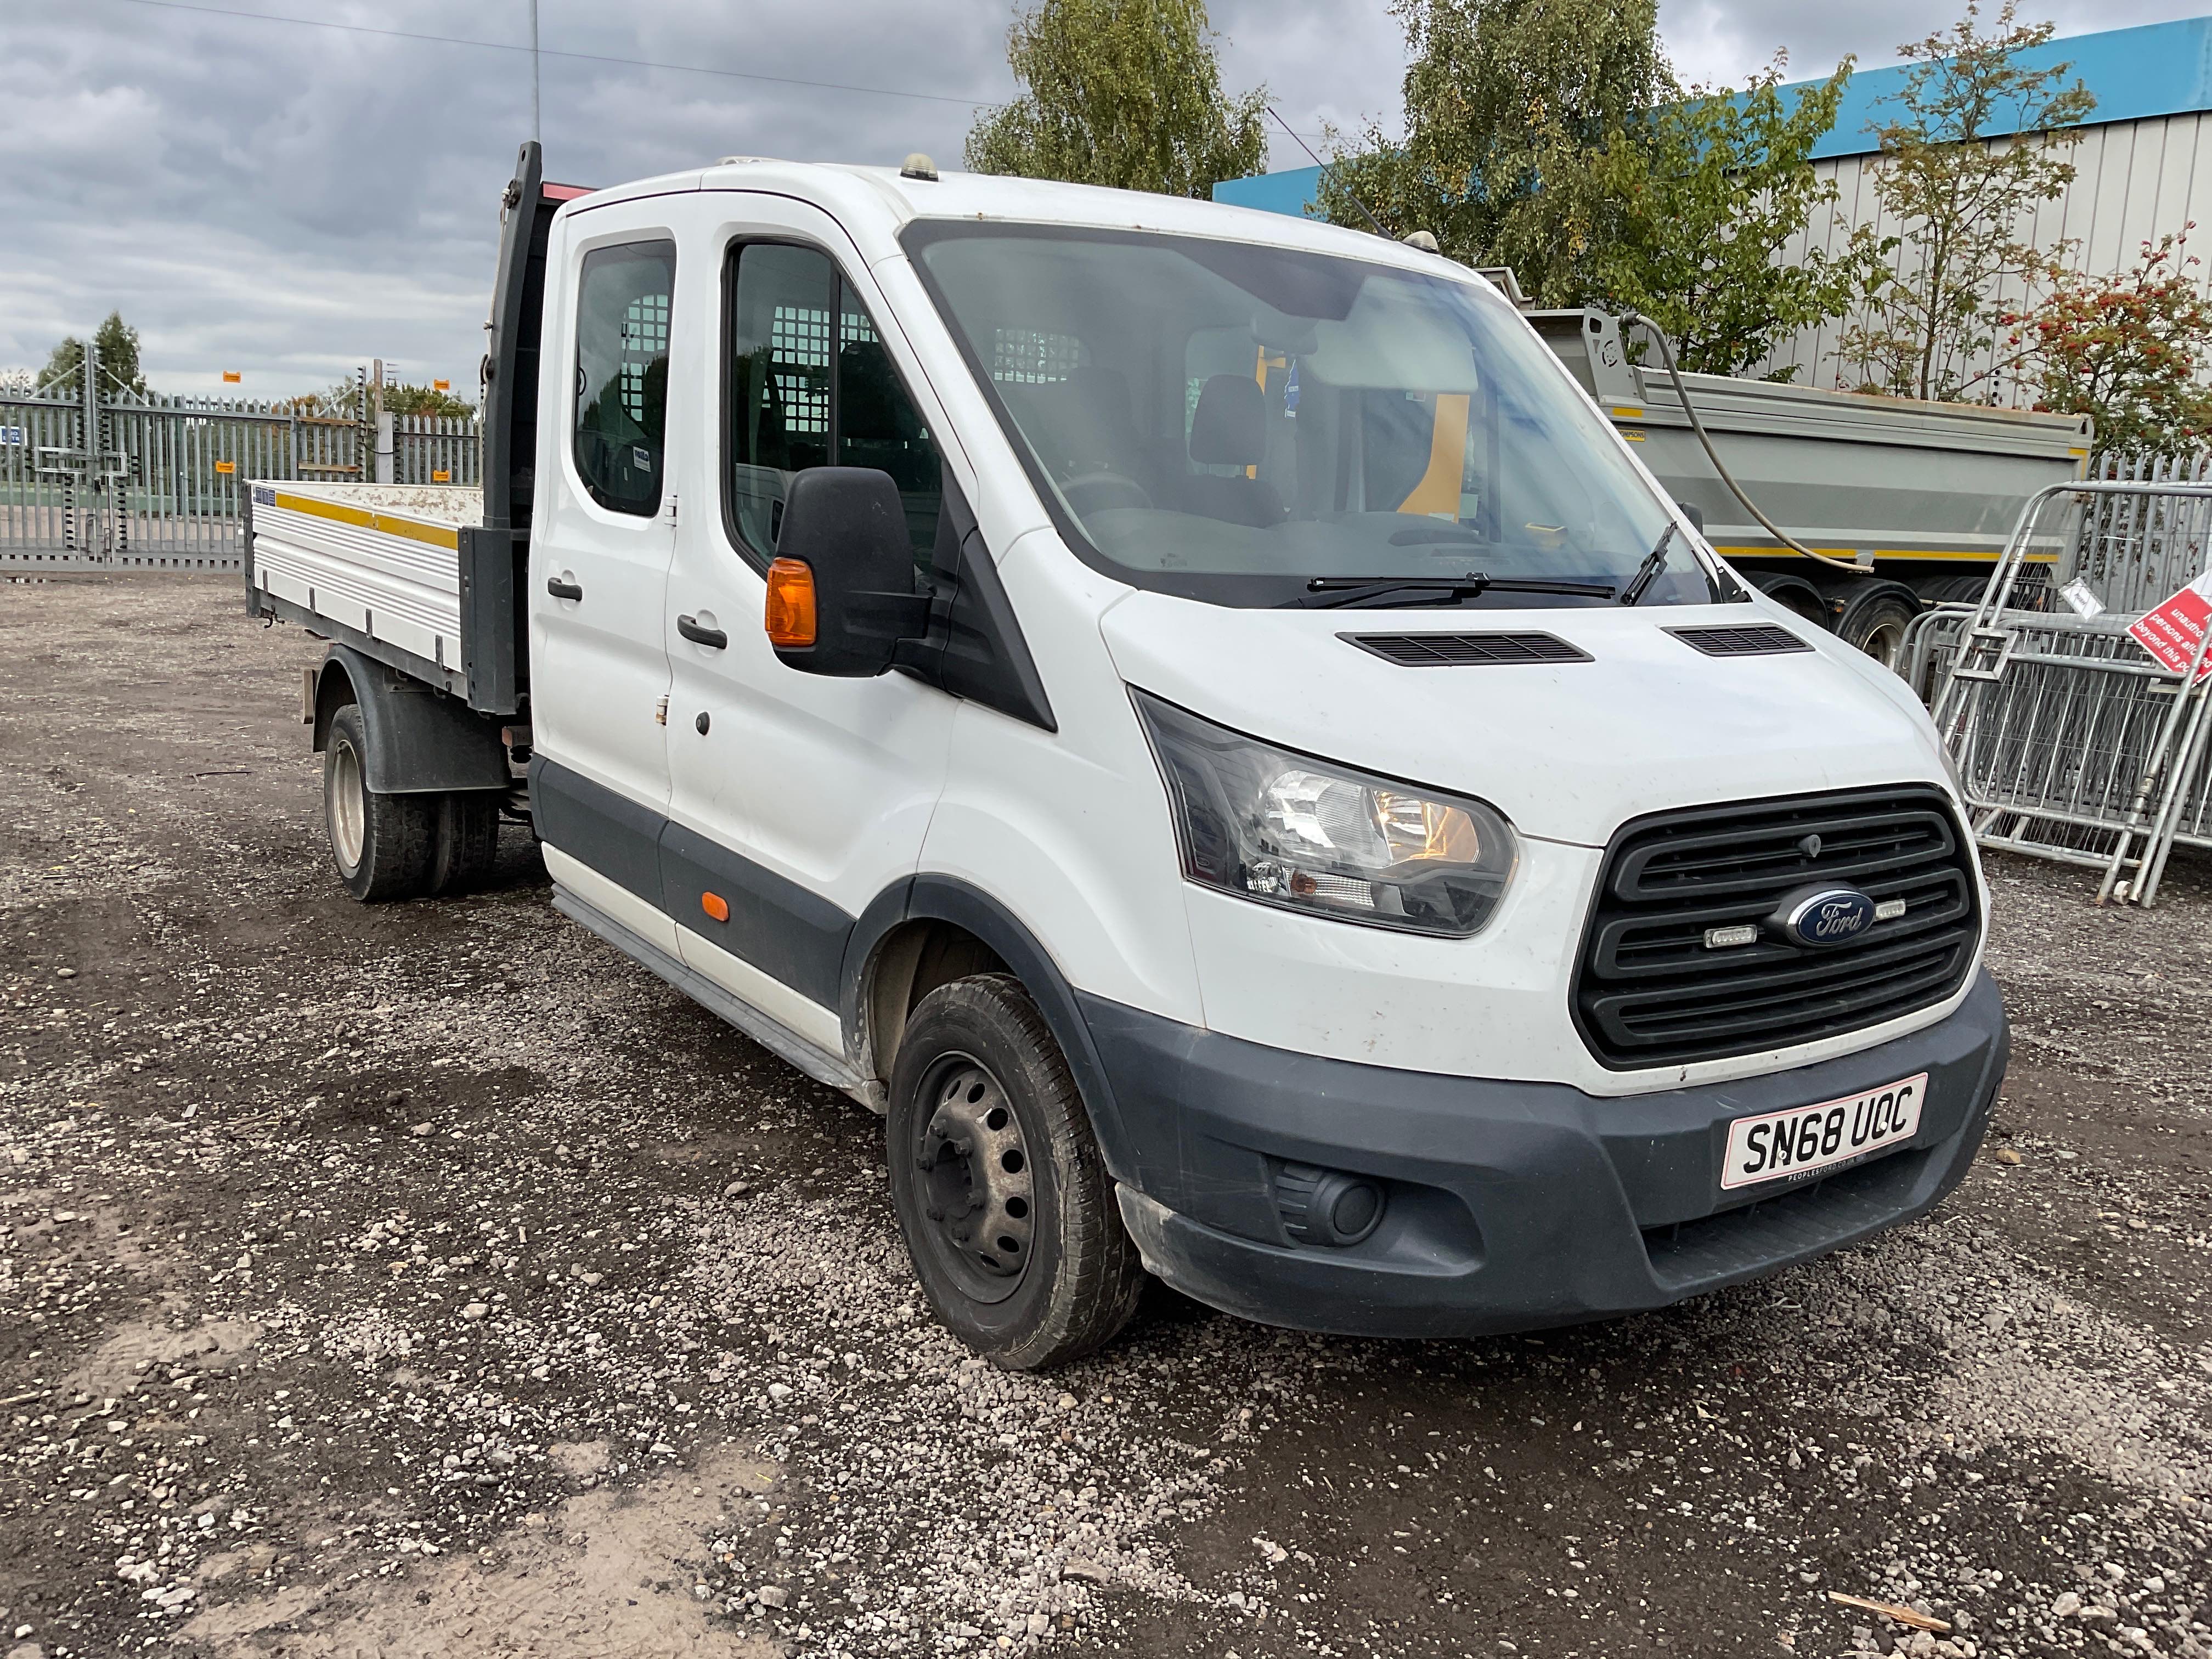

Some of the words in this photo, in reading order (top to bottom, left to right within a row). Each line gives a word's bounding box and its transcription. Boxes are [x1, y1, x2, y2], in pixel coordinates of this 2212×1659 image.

[2135, 621, 2168, 648] beyond
[2163, 646, 2181, 663] this
[2175, 661, 2202, 681] pot
[2149, 613, 2184, 642] persons
[2181, 641, 2212, 668] alloed
[2171, 608, 2212, 648] unautho
[1816, 901, 1864, 936] Ford
[1743, 1107, 1846, 1173] SN68
[1851, 1086, 1912, 1147] UOC
[1788, 1158, 1854, 1182] PEOPLESFORD.CO.UK
